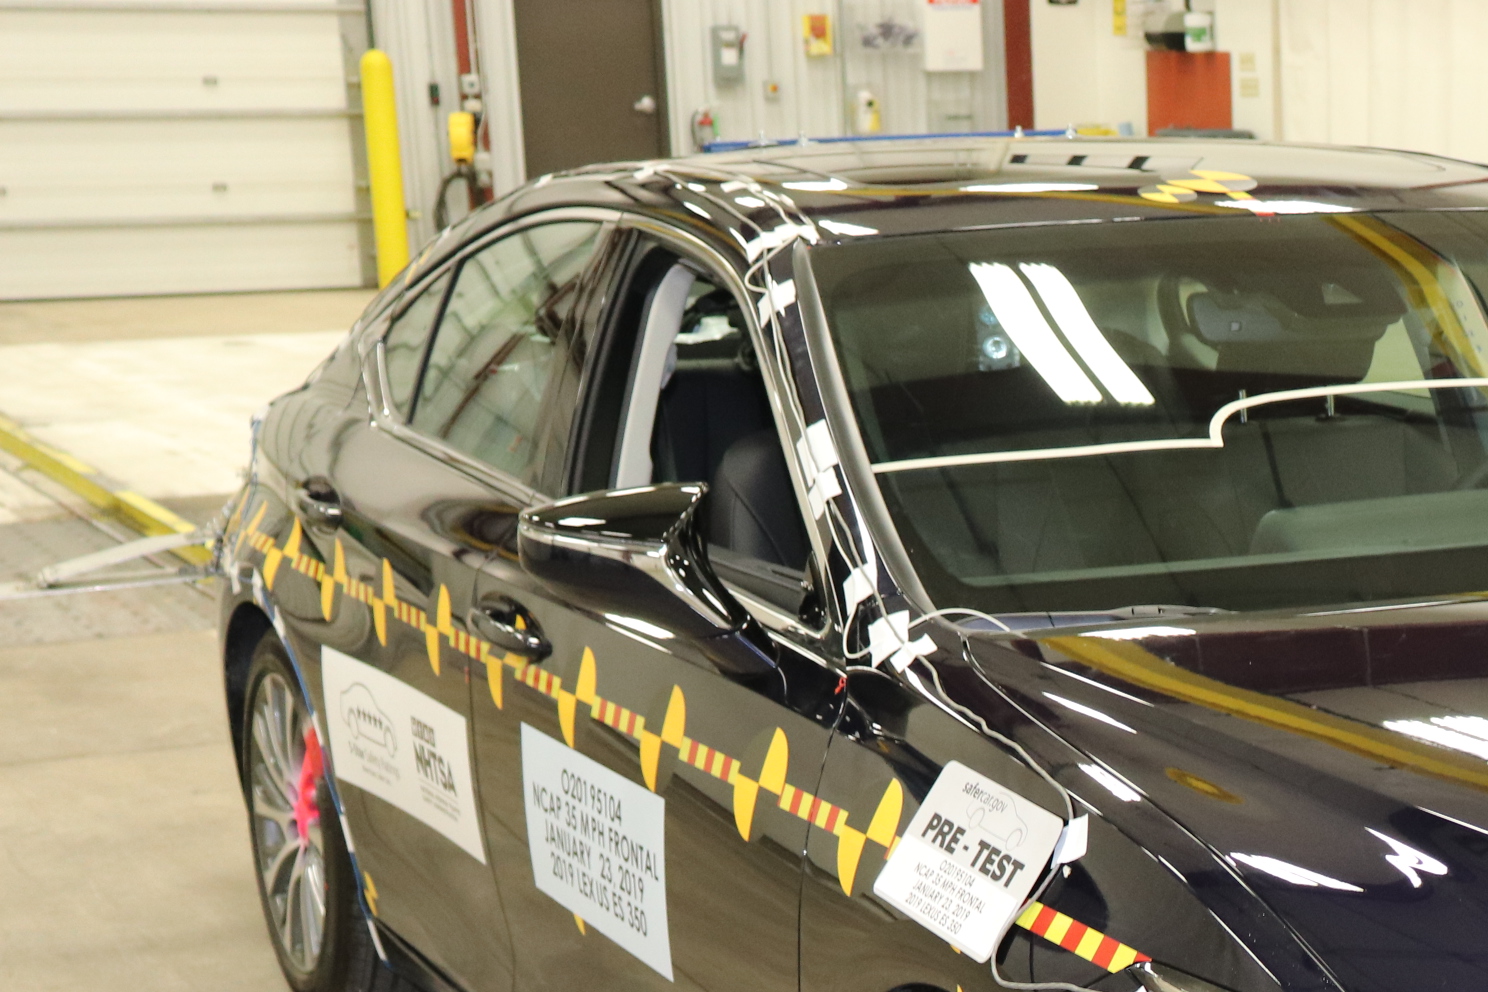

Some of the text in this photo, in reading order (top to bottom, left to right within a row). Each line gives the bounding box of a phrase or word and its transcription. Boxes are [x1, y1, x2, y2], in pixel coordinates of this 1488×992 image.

[413, 740, 458, 797] NHTSA
[962, 781, 1008, 813] safercar.gov
[533, 781, 659, 881] NCAP 35 MPH FRONTAL
[921, 812, 967, 855] PRE
[970, 839, 1025, 888] TEST
[545, 818, 592, 870] JANUARY
[618, 865, 644, 903] 2019
[914, 861, 986, 914] NCAP 35 MPH FRONTAL
[551, 851, 647, 937] 2019 LEXUS ES 350
[905, 891, 962, 935] 2019 LEXUS ES 350
[912, 879, 944, 904] JANUARY
[951, 904, 971, 922] 2019
